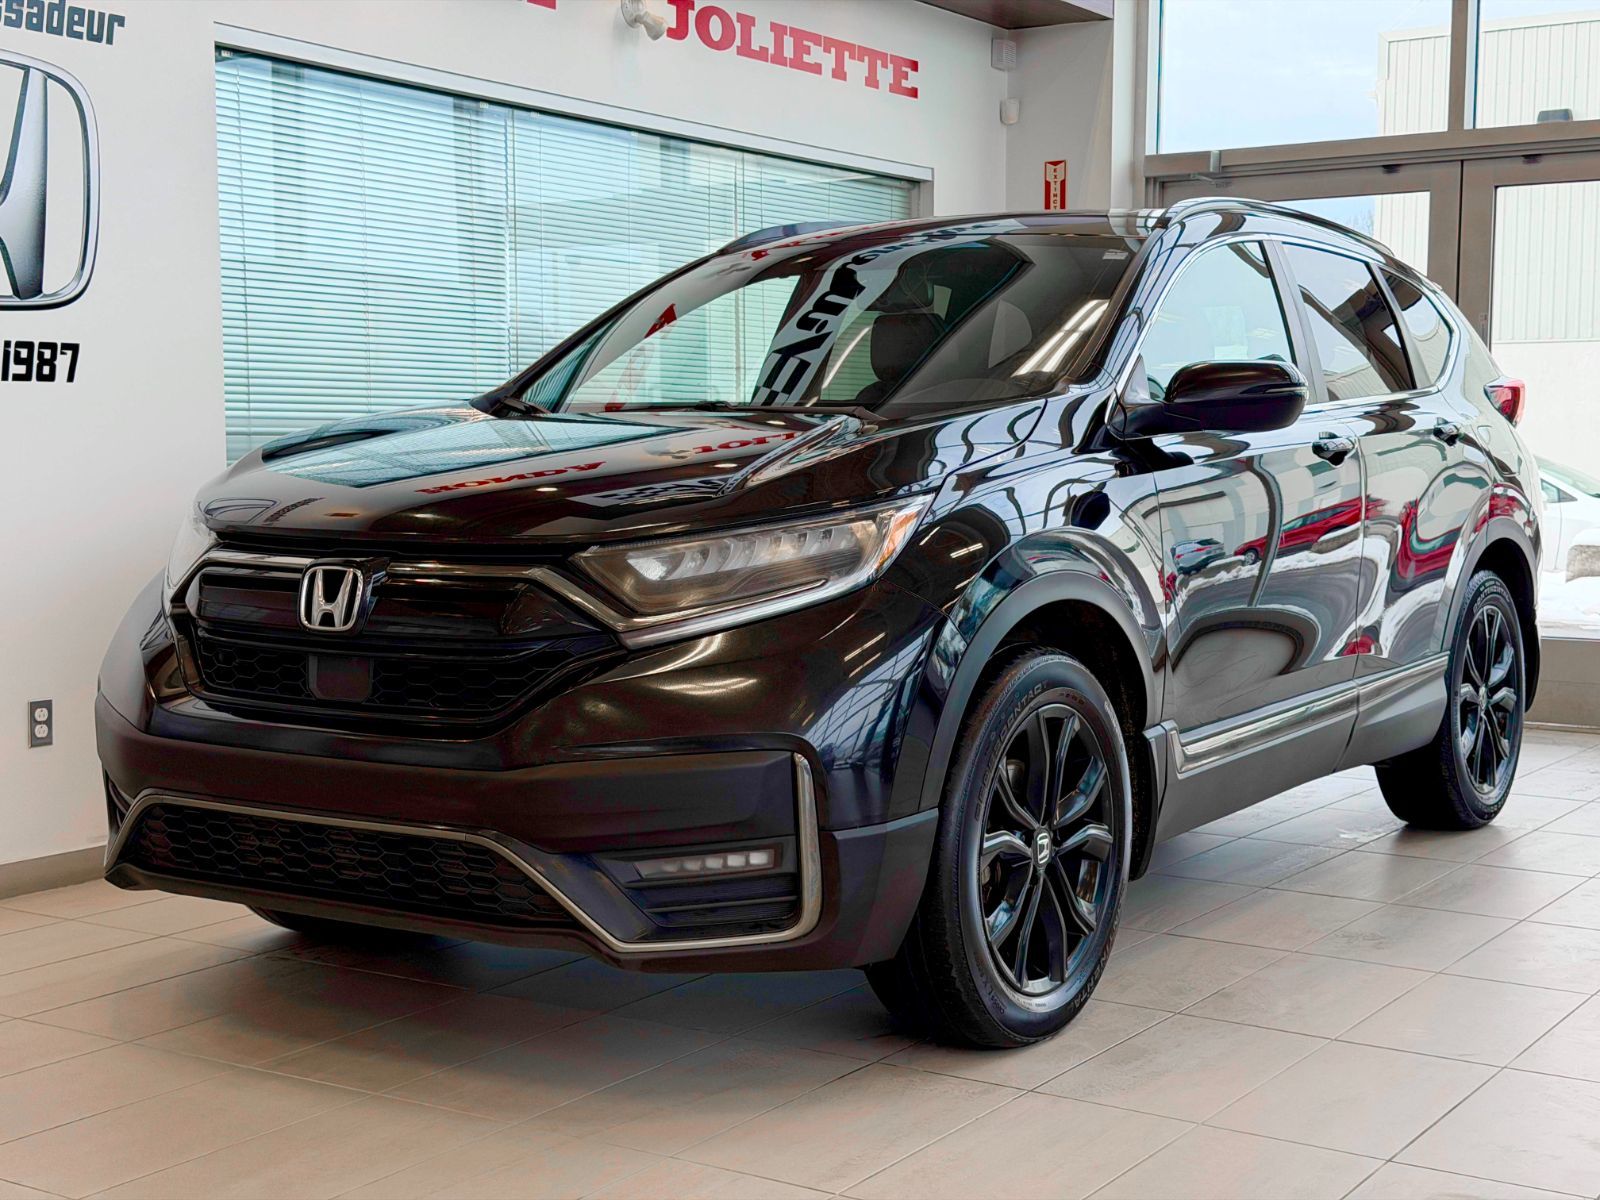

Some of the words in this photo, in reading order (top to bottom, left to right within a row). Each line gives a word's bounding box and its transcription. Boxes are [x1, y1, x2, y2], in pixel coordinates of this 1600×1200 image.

[0, 0, 126, 45] sadeur
[666, 0, 919, 99] JOLIETTE
[1, 339, 81, 383] 1987
